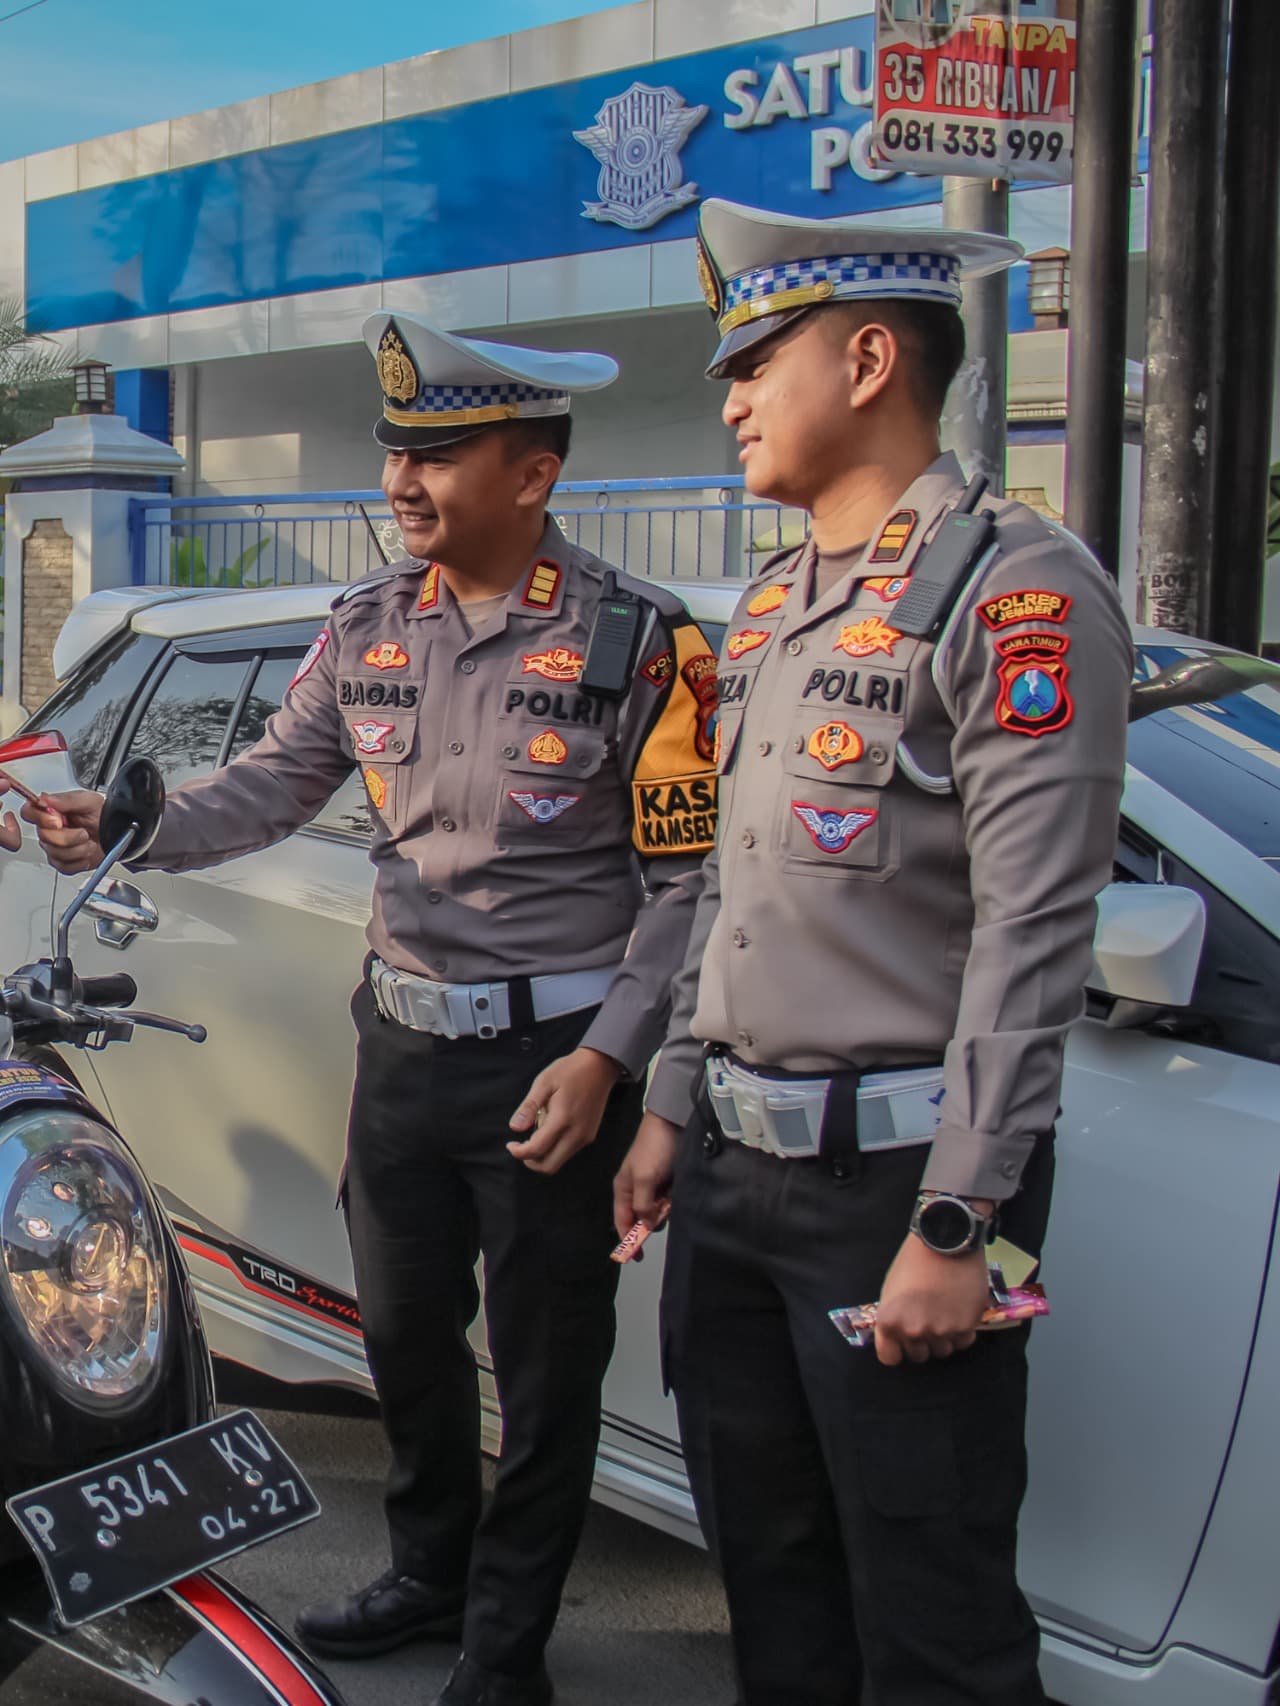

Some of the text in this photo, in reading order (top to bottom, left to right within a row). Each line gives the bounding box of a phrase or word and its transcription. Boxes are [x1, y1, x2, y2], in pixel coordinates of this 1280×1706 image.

[971, 18, 1068, 54] TANPA
[883, 52, 925, 103] 35
[883, 118, 1064, 162] 081 333 999
[985, 593, 1062, 620] POLRES
[998, 605, 1054, 622] JEMBER
[338, 680, 419, 708] BAGAS
[505, 689, 605, 725] POLRI
[802, 668, 904, 715] POLRI
[639, 780, 719, 820] KAS
[243, 1256, 296, 1293] TRD
[23, 1422, 273, 1552] P 5341 KV
